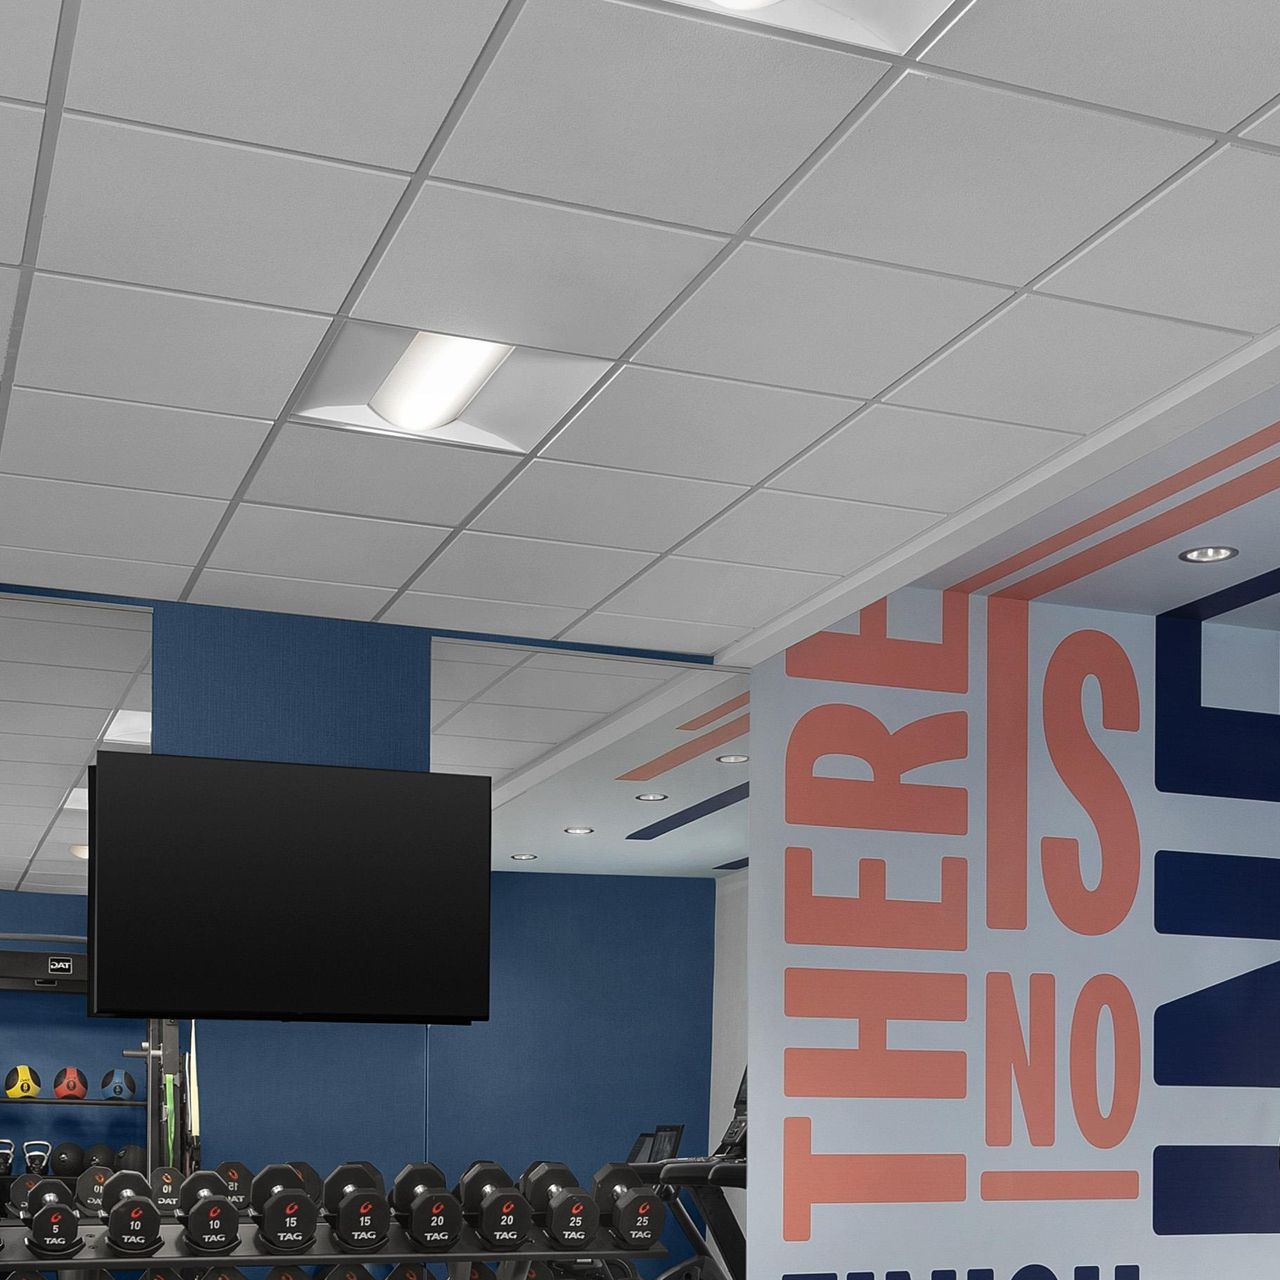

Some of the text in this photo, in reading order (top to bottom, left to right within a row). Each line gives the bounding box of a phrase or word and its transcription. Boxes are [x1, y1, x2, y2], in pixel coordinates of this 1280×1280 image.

[985, 596, 1141, 936] IS
[782, 591, 969, 1242] THERE
[985, 971, 1141, 1150] NO
[129, 1220, 142, 1231] 10
[208, 1219, 221, 1230] 10
[285, 1216, 298, 1228] 15
[359, 1215, 372, 1227] 15
[430, 1215, 445, 1227] 20
[500, 1215, 514, 1226] 20
[569, 1216, 583, 1227] 25
[635, 1216, 649, 1226] 25
[52, 1224, 60, 1234] 5
[121, 1235, 146, 1244] TAG
[202, 1233, 226, 1243] TAG
[277, 1232, 303, 1241] TAG
[351, 1230, 377, 1240] TAG
[423, 1231, 449, 1241] TAG
[493, 1231, 518, 1240] TAG
[562, 1230, 586, 1240] TAG
[629, 1230, 652, 1239] TAG
[43, 1237, 66, 1245] TAG
